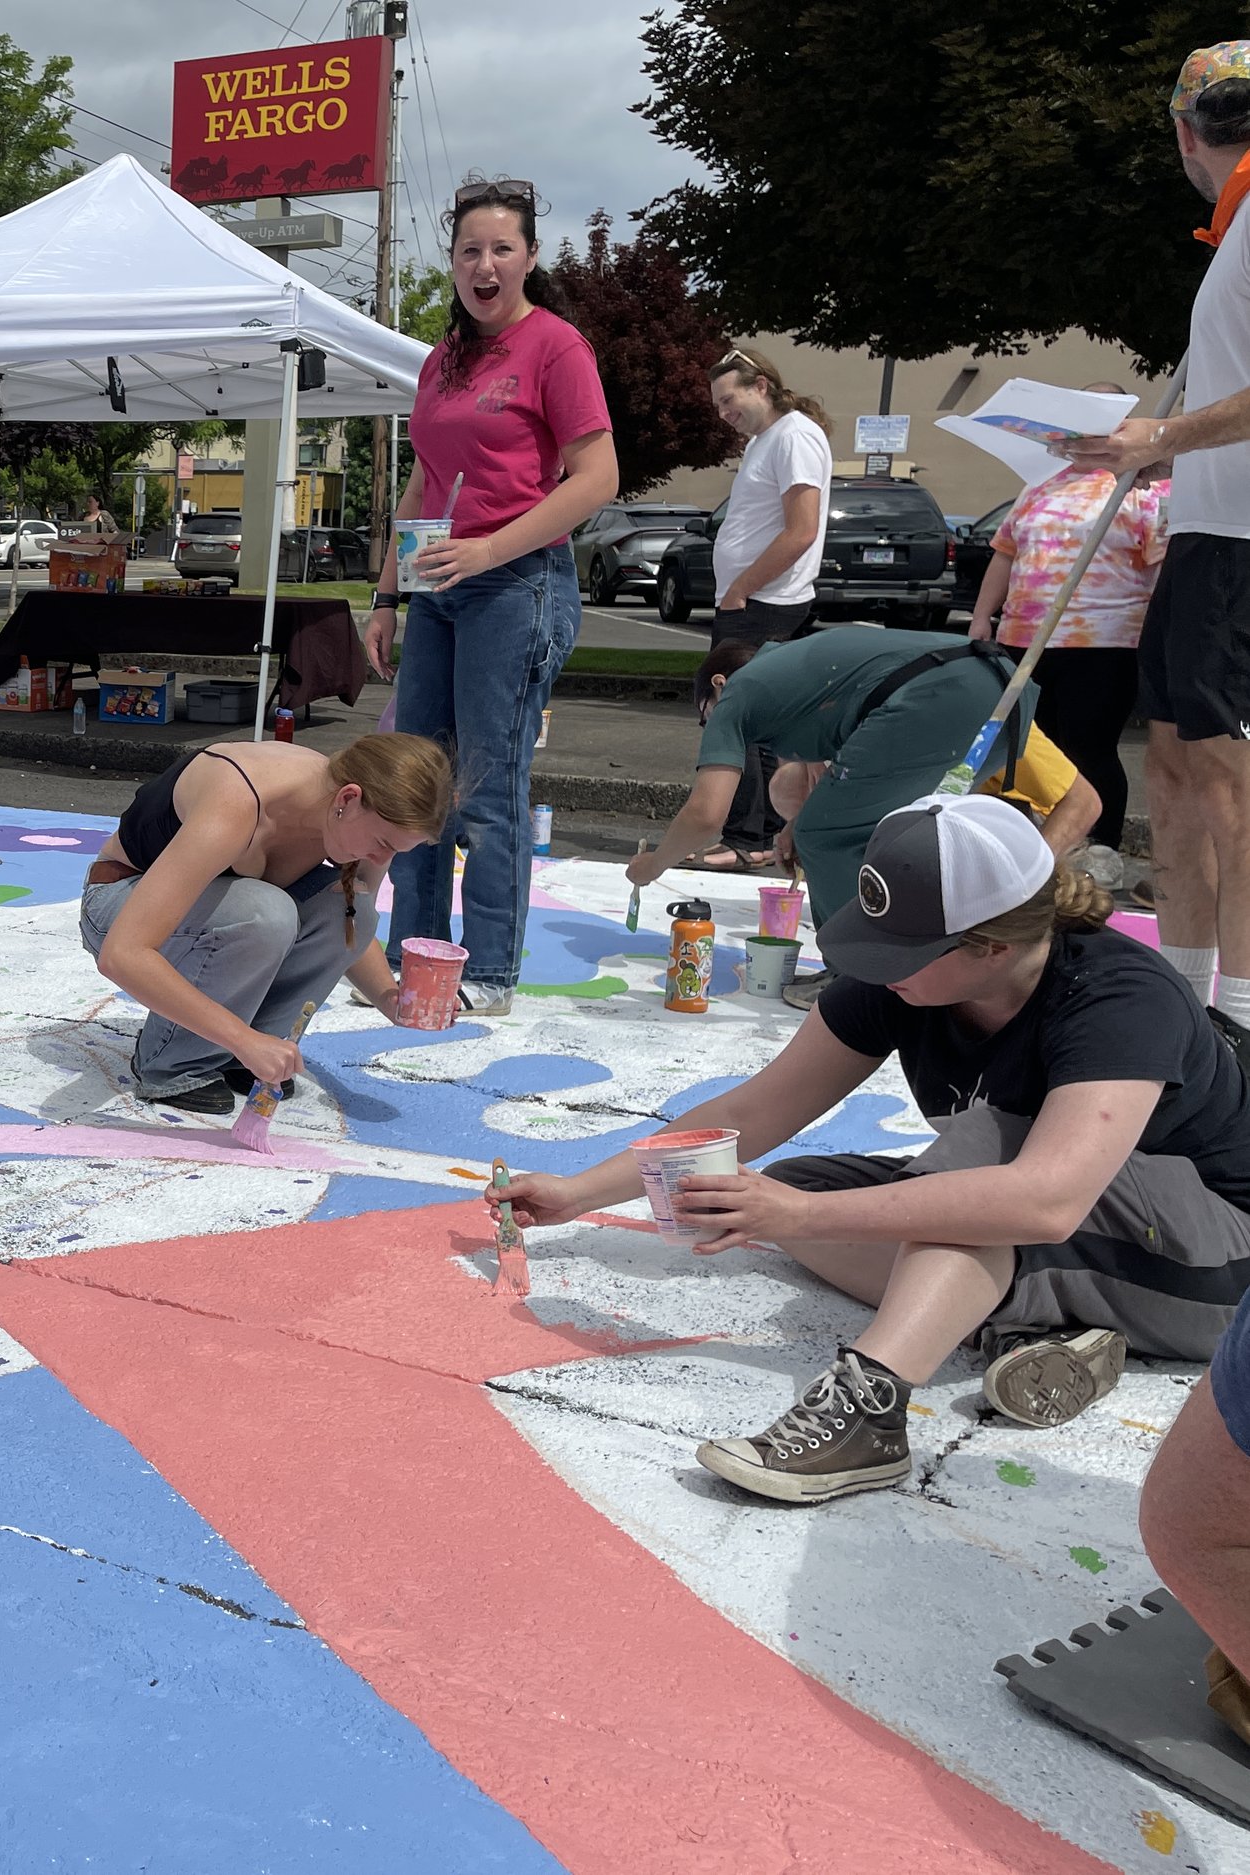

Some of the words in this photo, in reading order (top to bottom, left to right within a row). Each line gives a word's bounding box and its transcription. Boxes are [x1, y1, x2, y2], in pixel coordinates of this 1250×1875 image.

[202, 56, 350, 103] WELLS
[204, 98, 348, 142] FARGO
[237, 227, 274, 239] ive-Up
[278, 224, 306, 236] ATM
